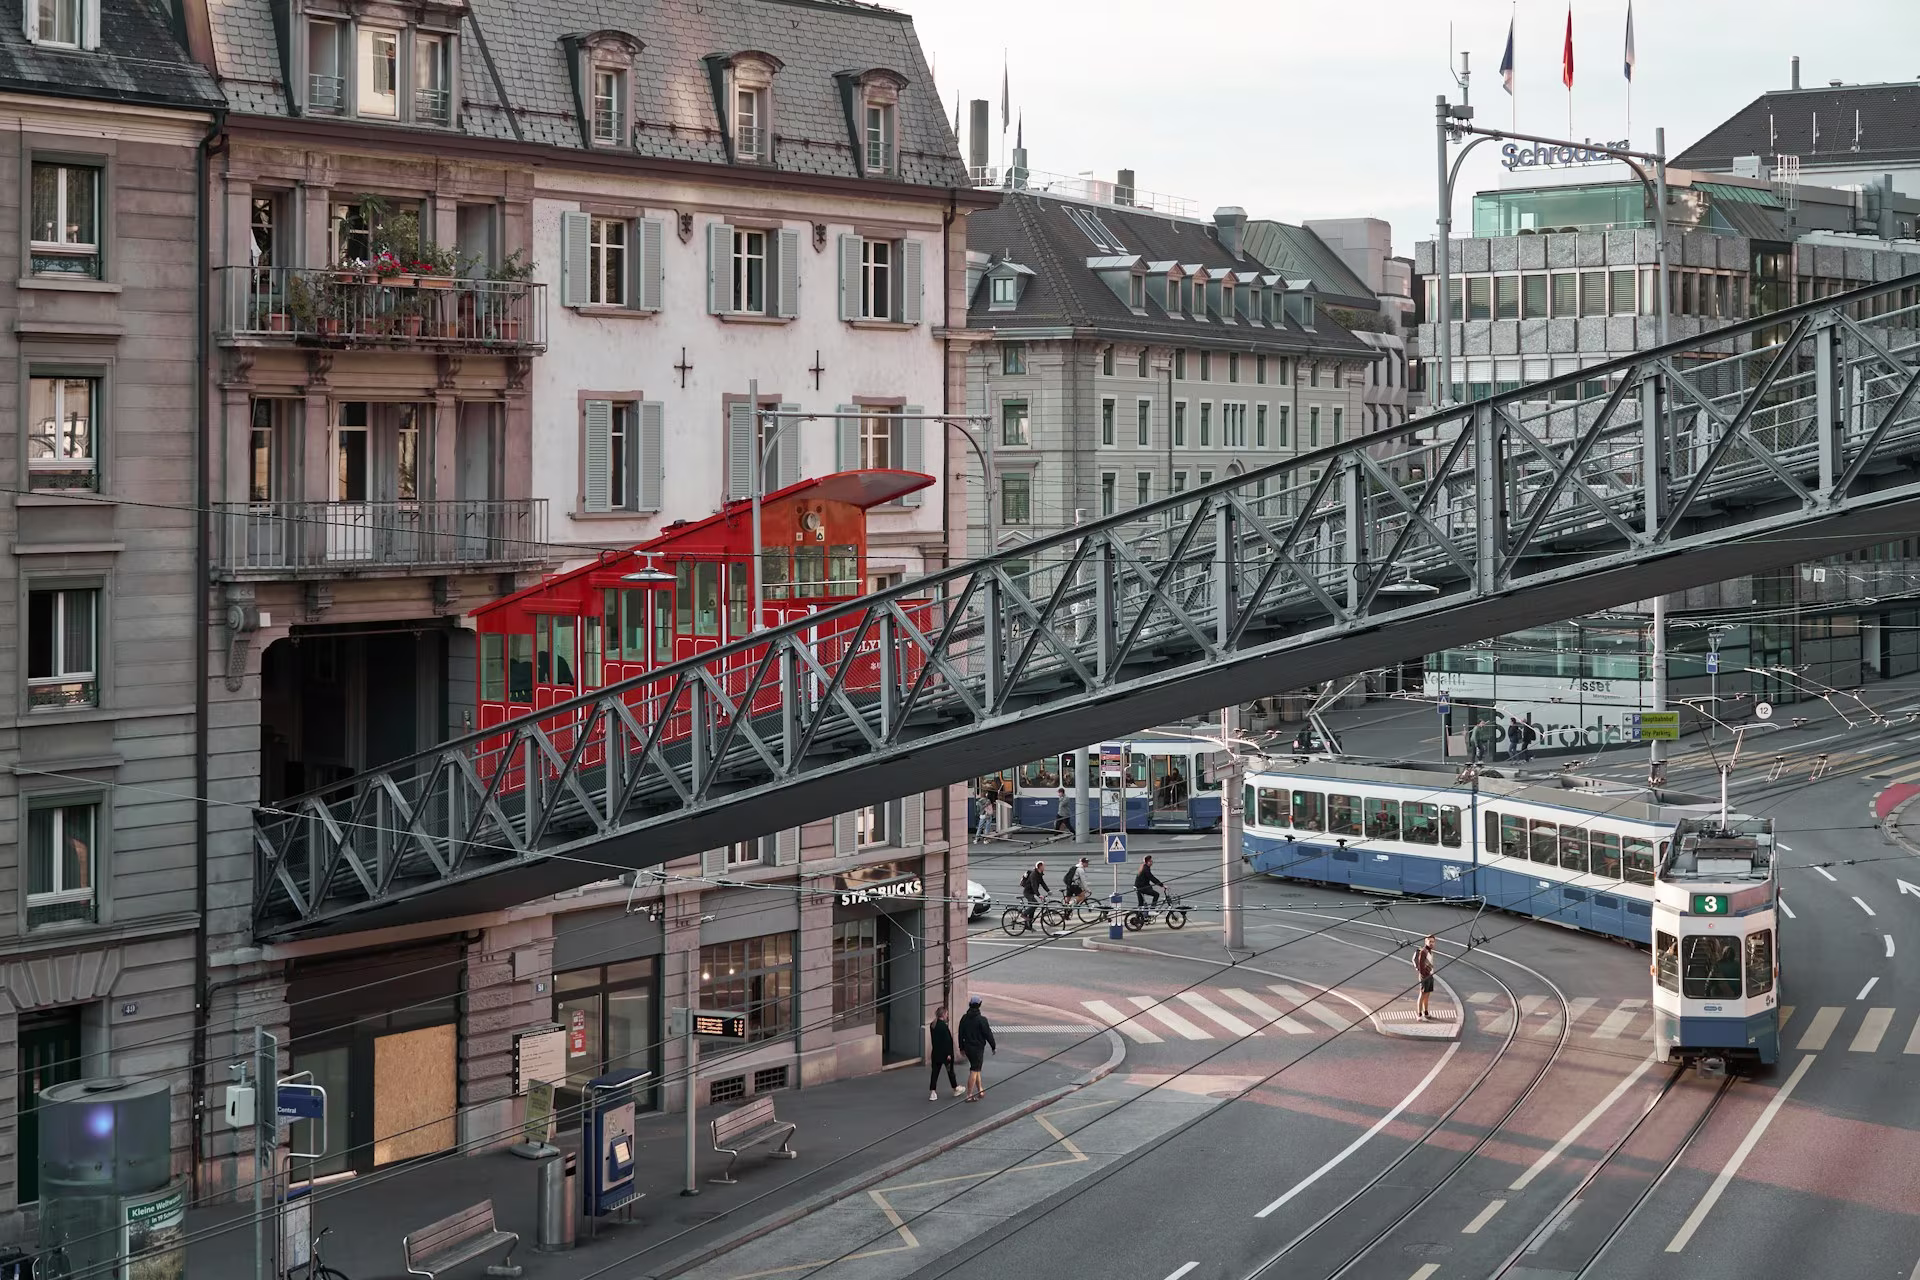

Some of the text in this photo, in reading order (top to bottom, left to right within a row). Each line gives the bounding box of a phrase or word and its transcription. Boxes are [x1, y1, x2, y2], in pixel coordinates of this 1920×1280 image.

[1760, 707, 1768, 715] 12
[1704, 896, 1718, 912] 3
[132, 1206, 155, 1217] Kleine
